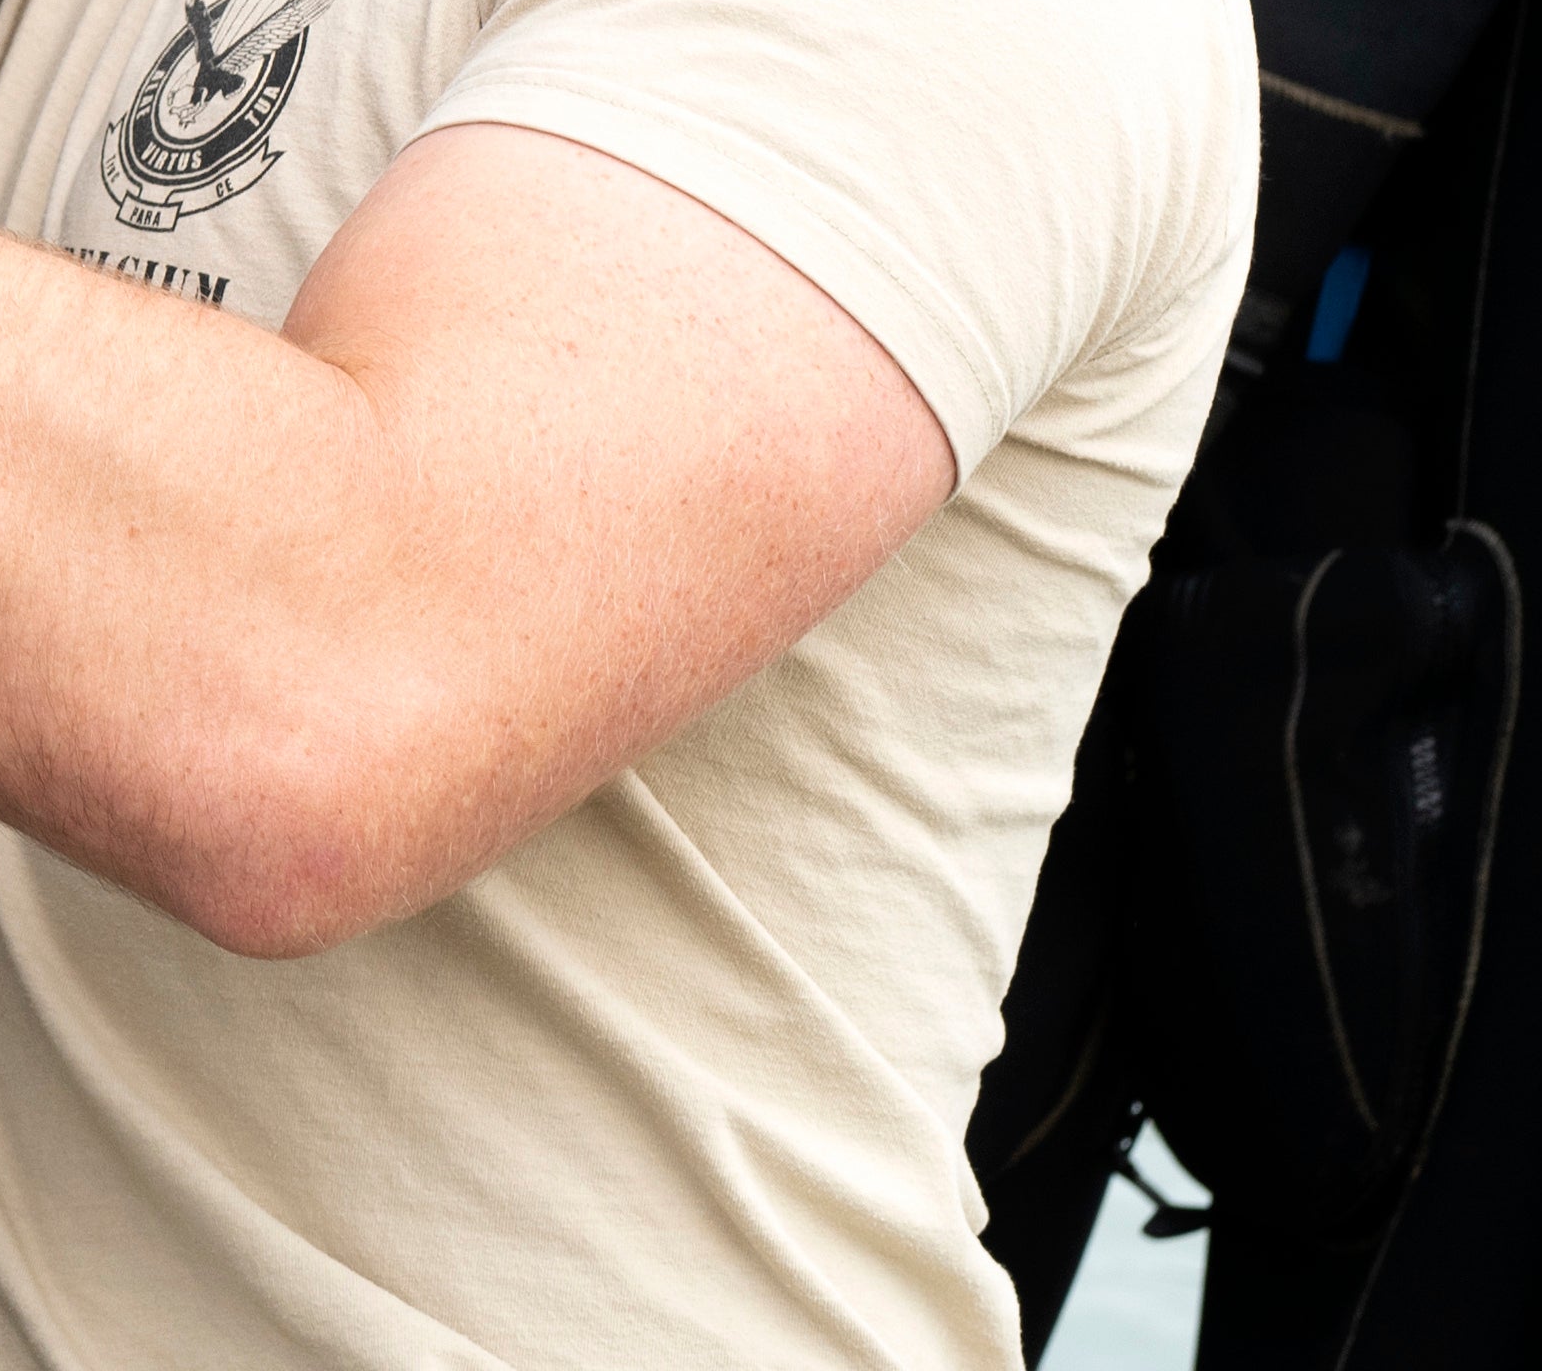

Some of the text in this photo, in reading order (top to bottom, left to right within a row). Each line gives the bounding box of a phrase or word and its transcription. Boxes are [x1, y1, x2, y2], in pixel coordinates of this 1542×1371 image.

[244, 85, 282, 128] TUA
[140, 140, 204, 172] VIRTUS
[215, 177, 235, 199] CE
[129, 207, 162, 227] PARA
